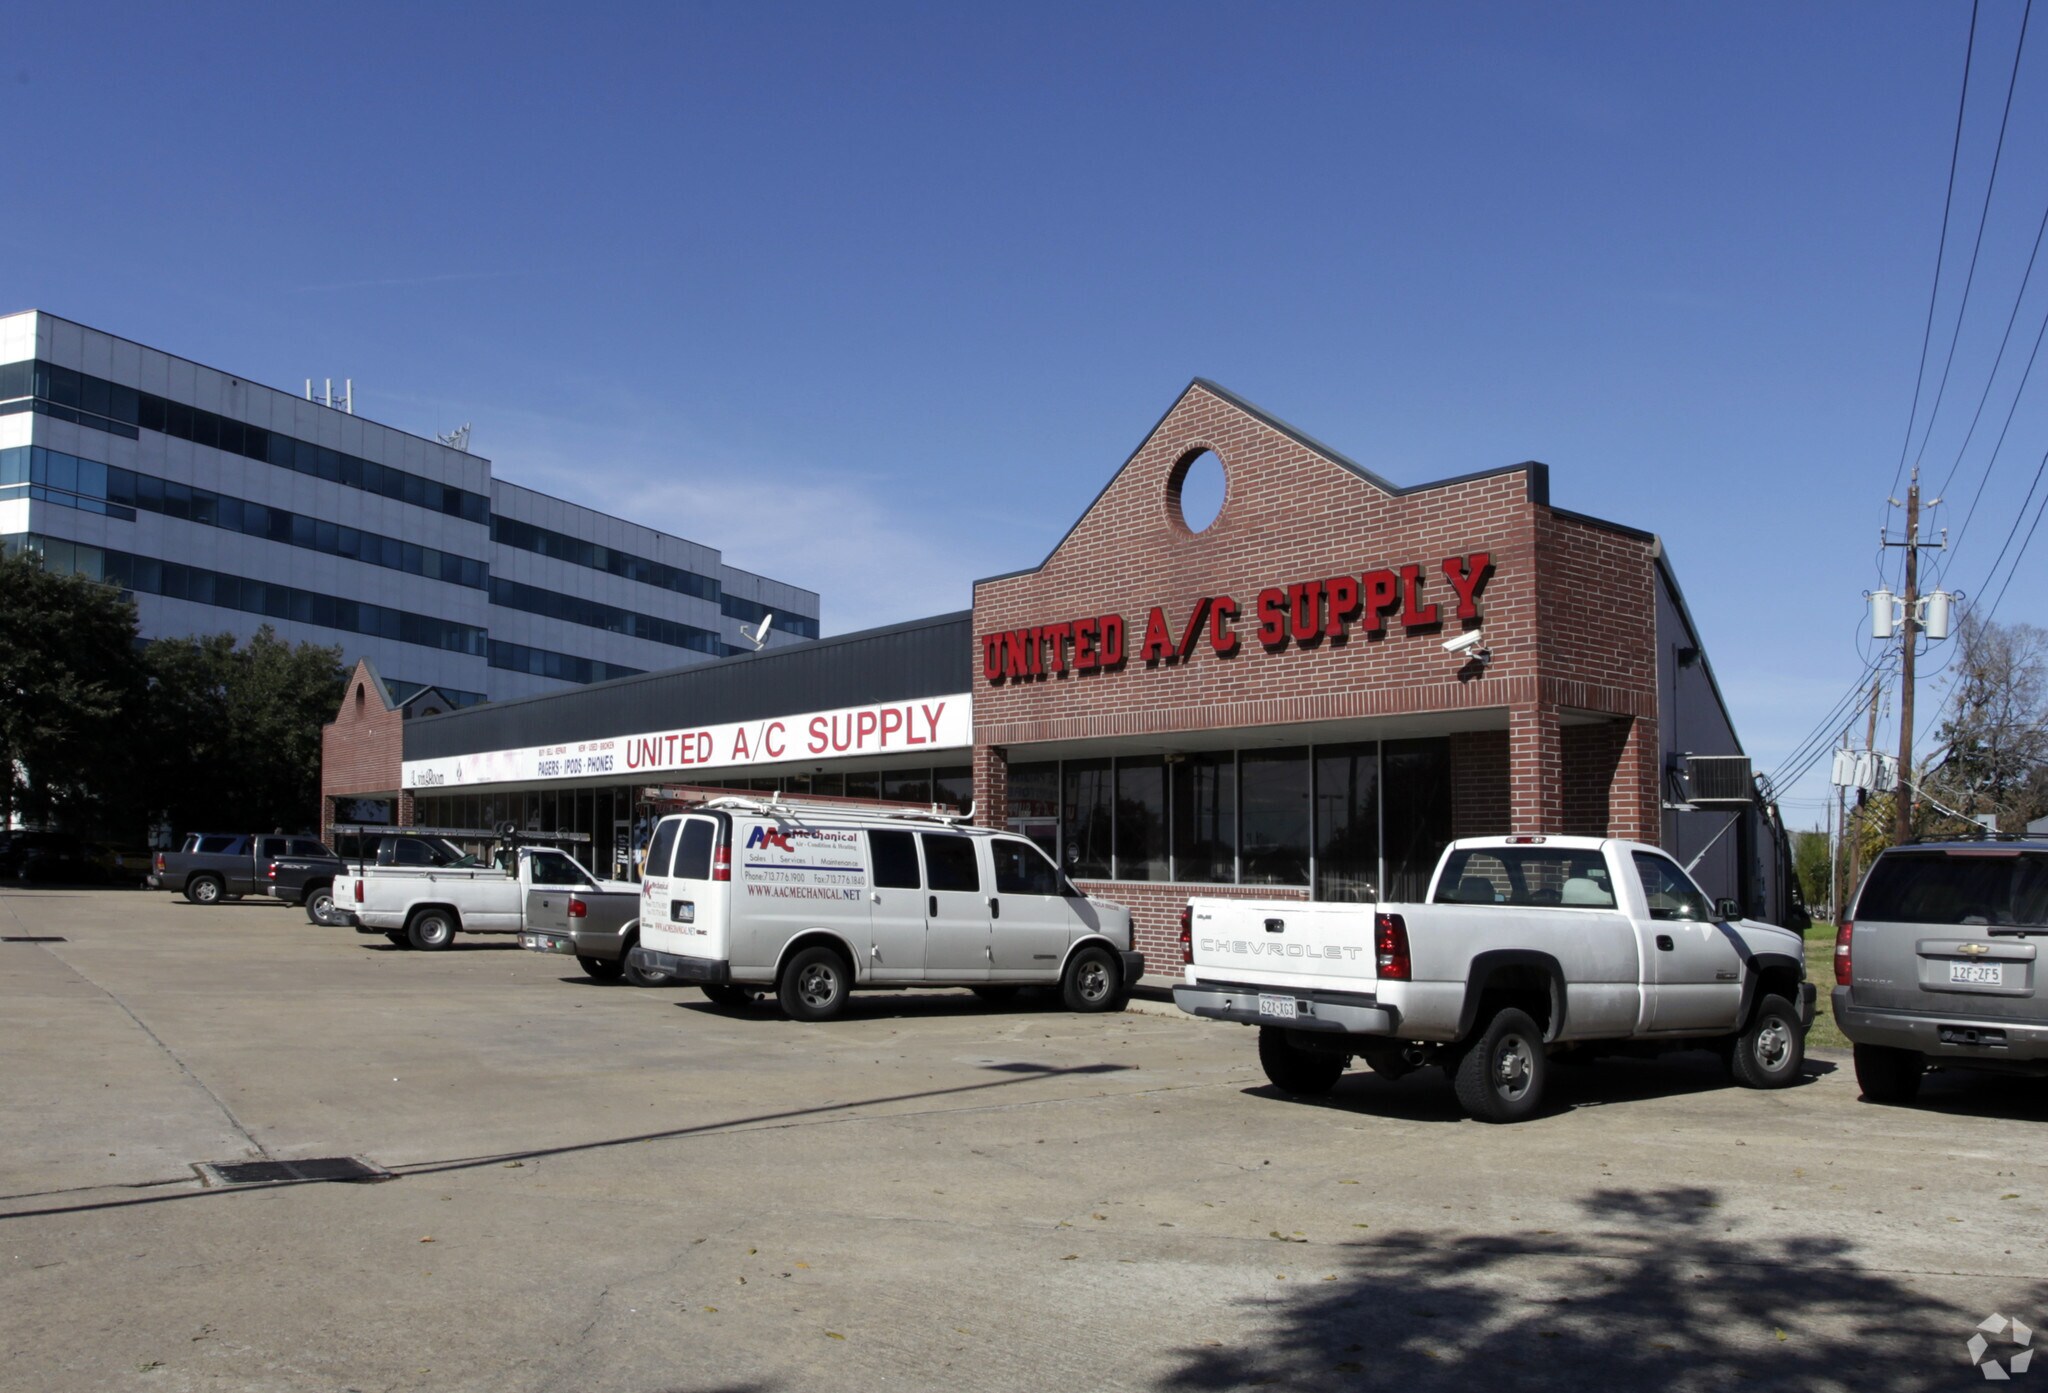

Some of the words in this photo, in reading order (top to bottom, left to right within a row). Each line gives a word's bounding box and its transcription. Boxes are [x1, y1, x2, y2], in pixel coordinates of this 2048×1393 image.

[982, 613, 1127, 682] UNITED
[1140, 594, 1241, 663] A/C
[1256, 552, 1496, 651] SUPPLY
[626, 731, 713, 769] UNITED
[731, 721, 786, 763] A/C
[807, 702, 947, 755] SUPPLY
[538, 760, 560, 777] PAGERS
[564, 758, 582, 775] IPODS
[586, 755, 614, 773] PHONES
[791, 829, 857, 843] Mechanical
[749, 854, 767, 863] Sales
[779, 855, 806, 865] Services
[820, 858, 859, 867] Maintenance
[747, 884, 862, 901] WWW.AACMECHANICAL.NET
[1200, 938, 1363, 961] CHEVROLET
